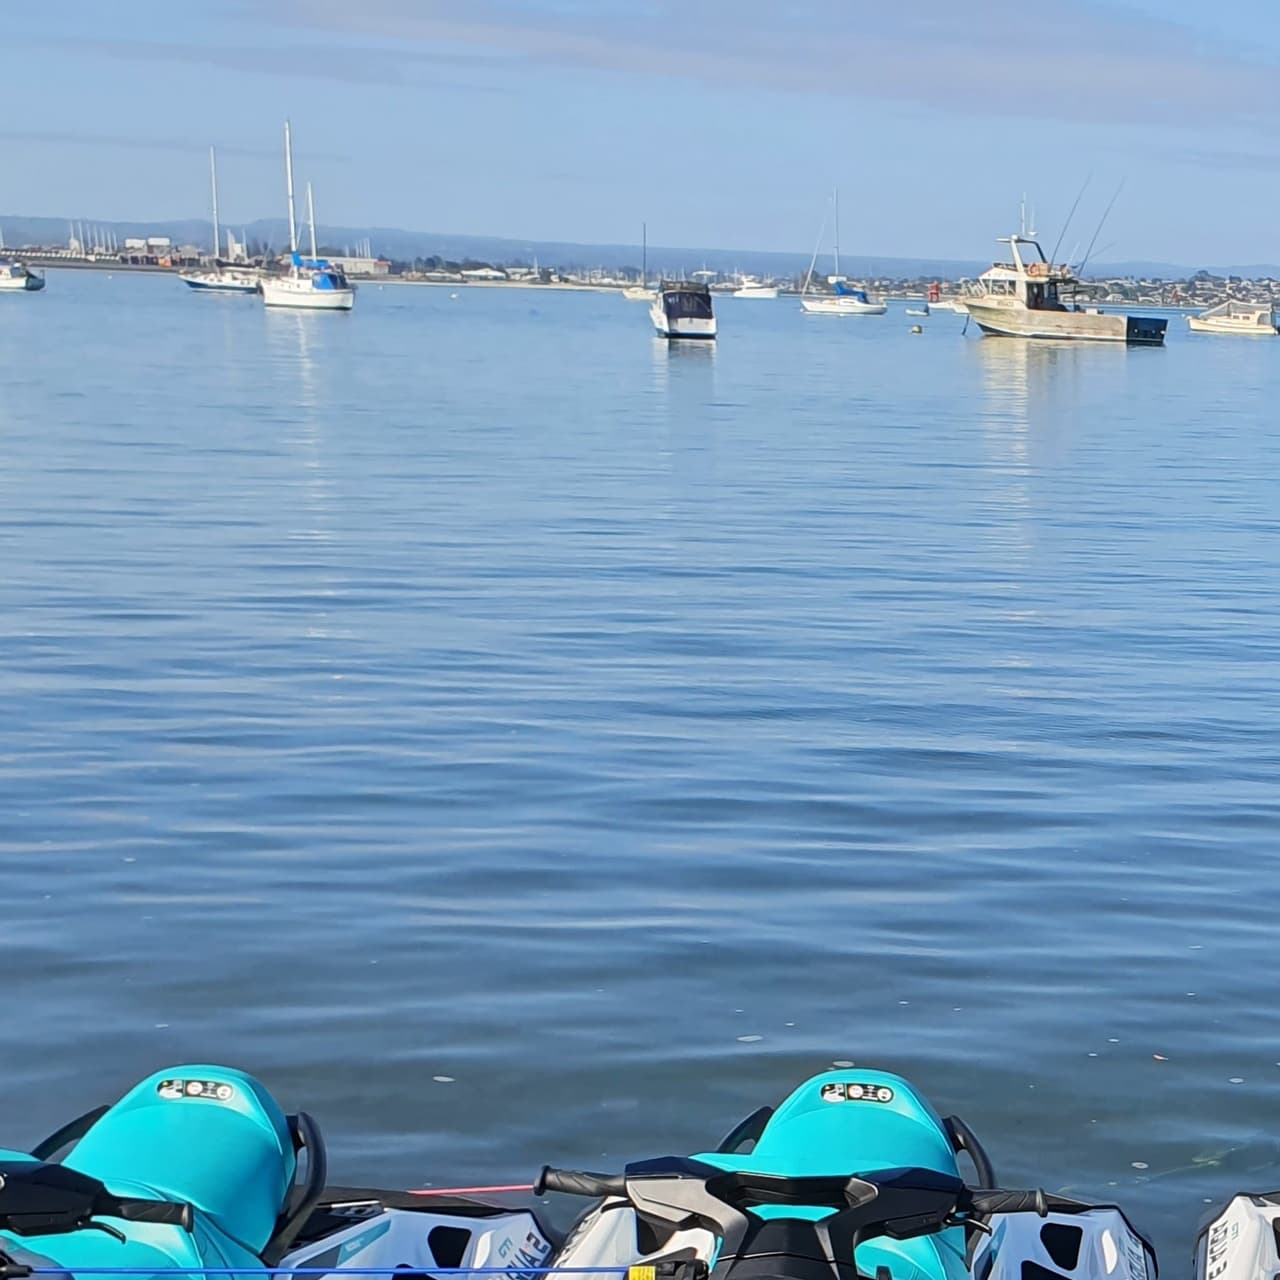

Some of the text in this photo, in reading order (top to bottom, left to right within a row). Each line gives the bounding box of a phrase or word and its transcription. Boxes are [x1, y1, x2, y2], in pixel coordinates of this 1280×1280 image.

[526, 1232, 549, 1254] 2
[1208, 1220, 1228, 1280] AQUA 3
